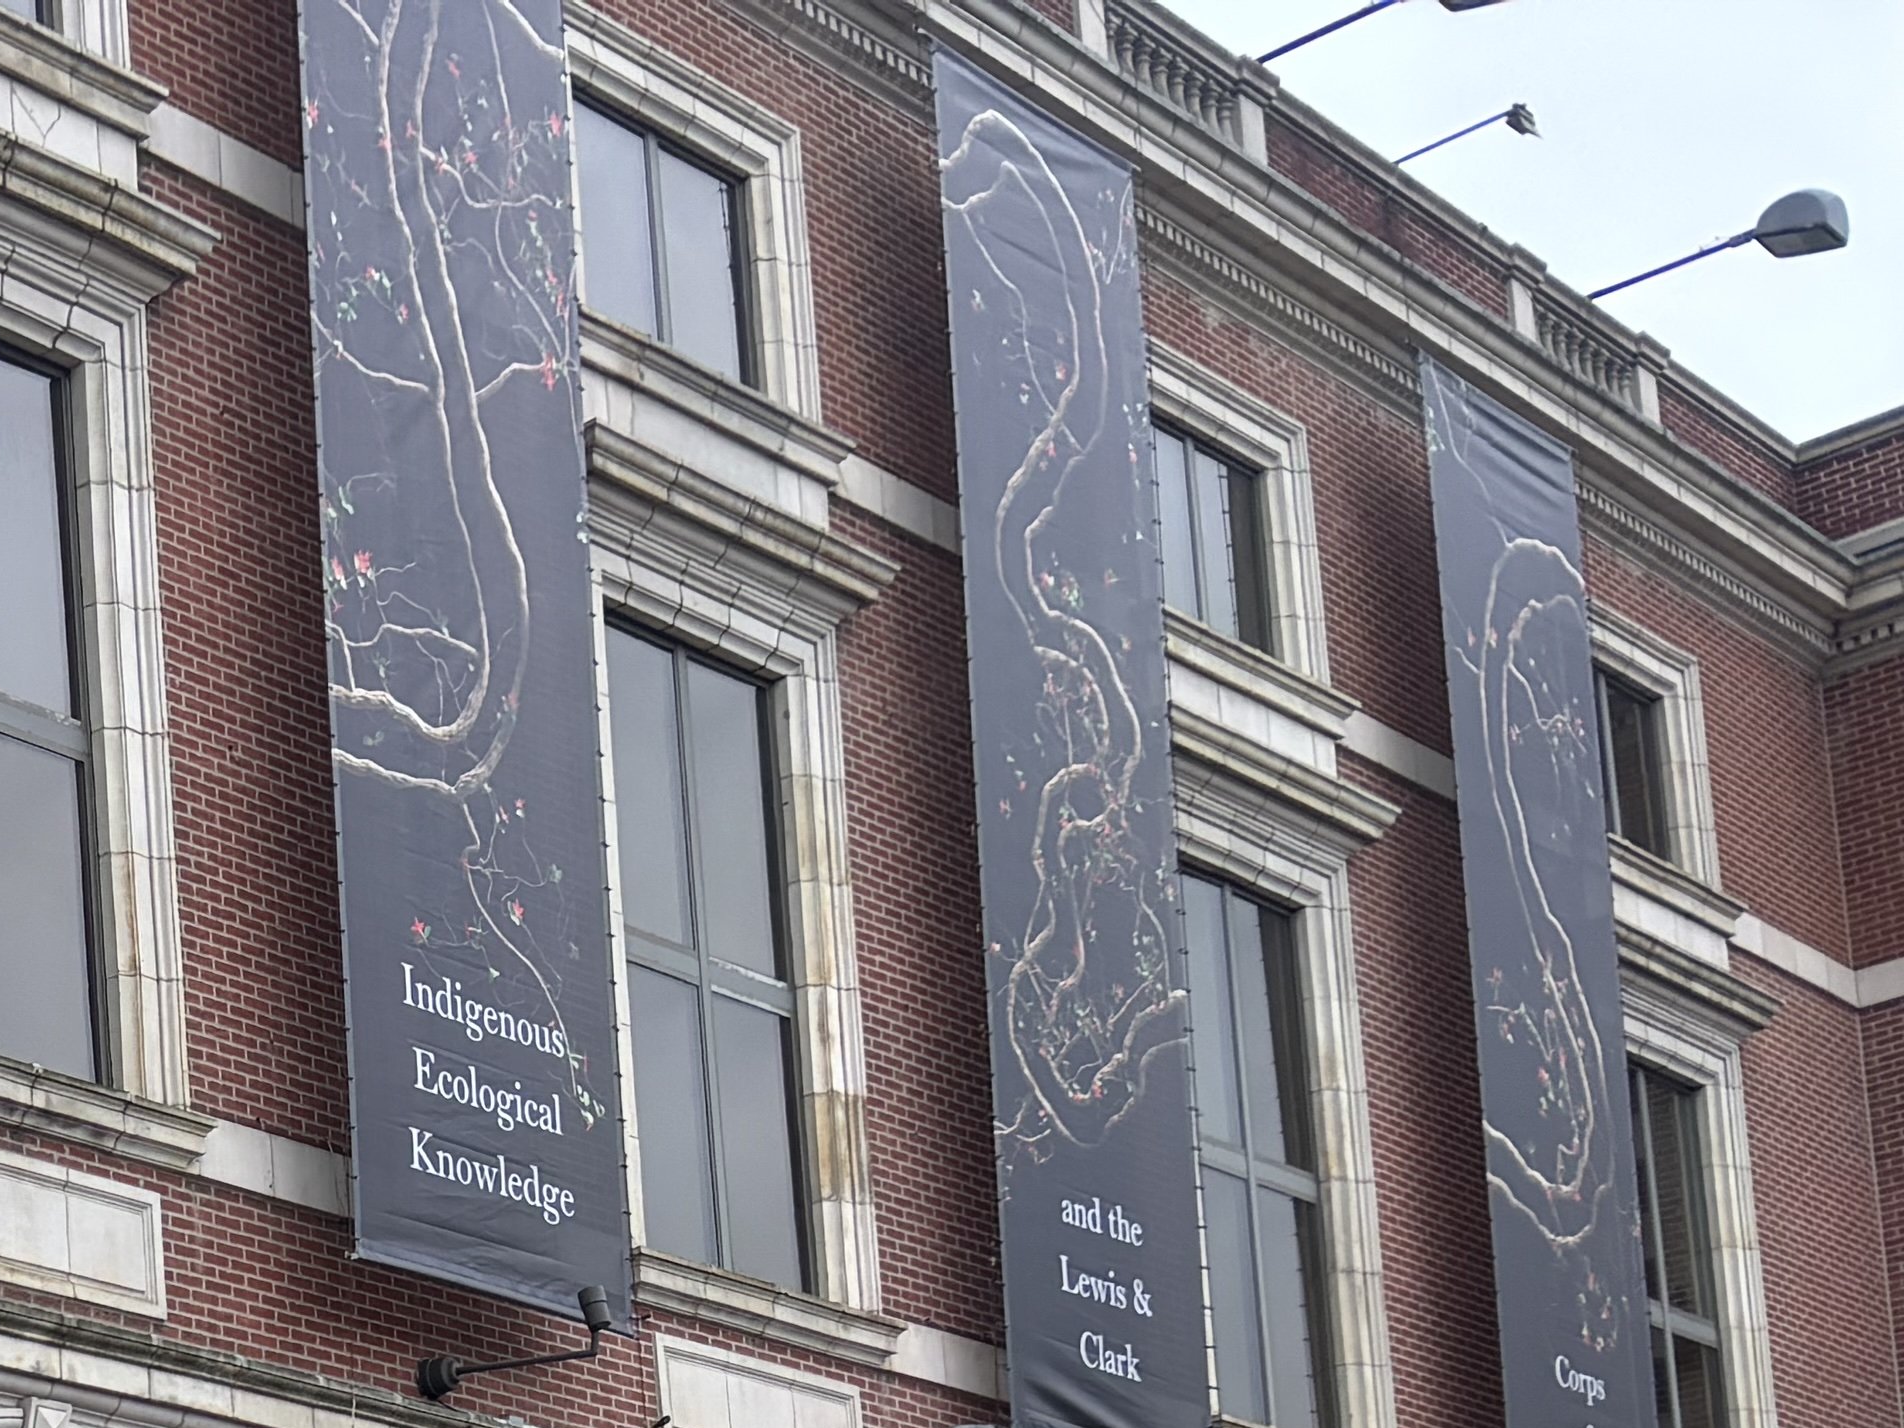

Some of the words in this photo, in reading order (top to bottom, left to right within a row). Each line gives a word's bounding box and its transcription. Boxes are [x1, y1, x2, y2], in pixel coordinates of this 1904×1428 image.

[400, 961, 565, 1059] Indigenous
[411, 1046, 564, 1136] Ecological
[408, 1126, 576, 1225] Knowledge
[1060, 1197, 1103, 1234] and
[1107, 1205, 1143, 1247] the
[1059, 1254, 1127, 1310] Lewis
[1132, 1278, 1153, 1317] &
[1079, 1330, 1142, 1382] Clark
[1554, 1354, 1606, 1406] Corps
